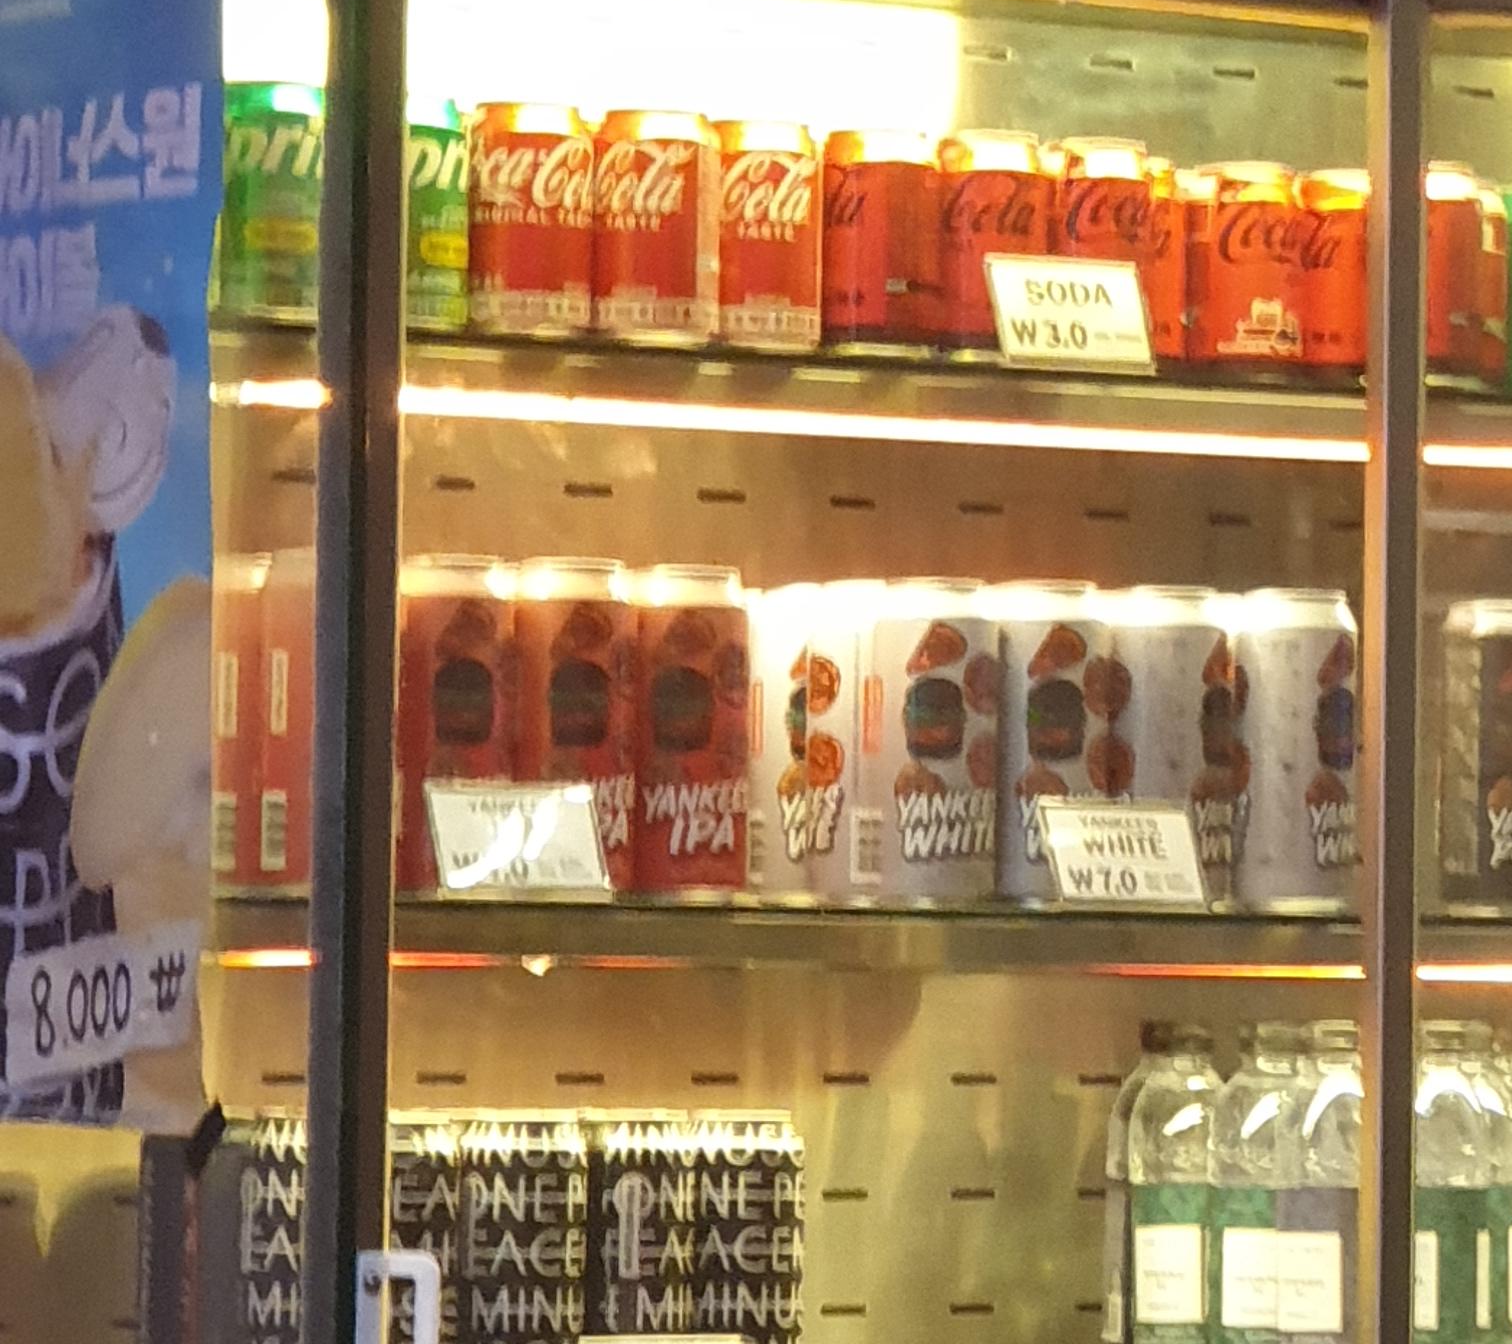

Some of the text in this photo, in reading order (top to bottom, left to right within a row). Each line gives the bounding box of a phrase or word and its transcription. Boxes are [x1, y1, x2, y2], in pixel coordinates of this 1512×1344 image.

[719, 151, 818, 227] Cola
[1026, 279, 1113, 307] SODA
[669, 810, 735, 857] IPA
[1083, 834, 1168, 860] WHITE
